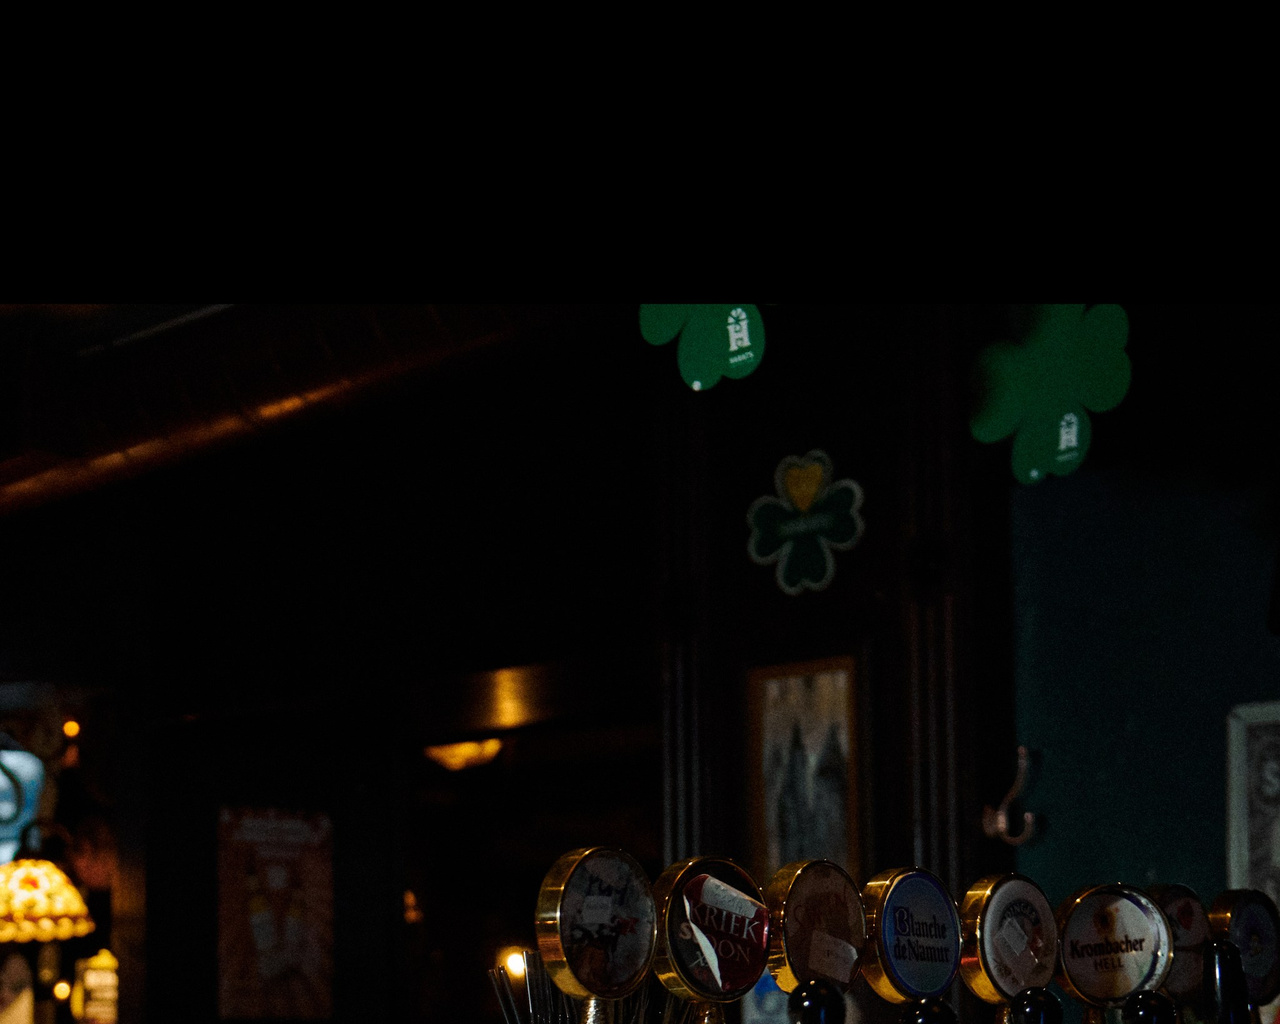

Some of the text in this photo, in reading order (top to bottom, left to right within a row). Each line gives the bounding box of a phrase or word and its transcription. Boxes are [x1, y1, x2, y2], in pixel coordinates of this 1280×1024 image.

[690, 902, 761, 944] KRIEK
[894, 906, 947, 939] Blanche
[893, 936, 950, 963] de Namur
[1070, 934, 1146, 960] Krombacher
[1094, 957, 1125, 972] HELL
